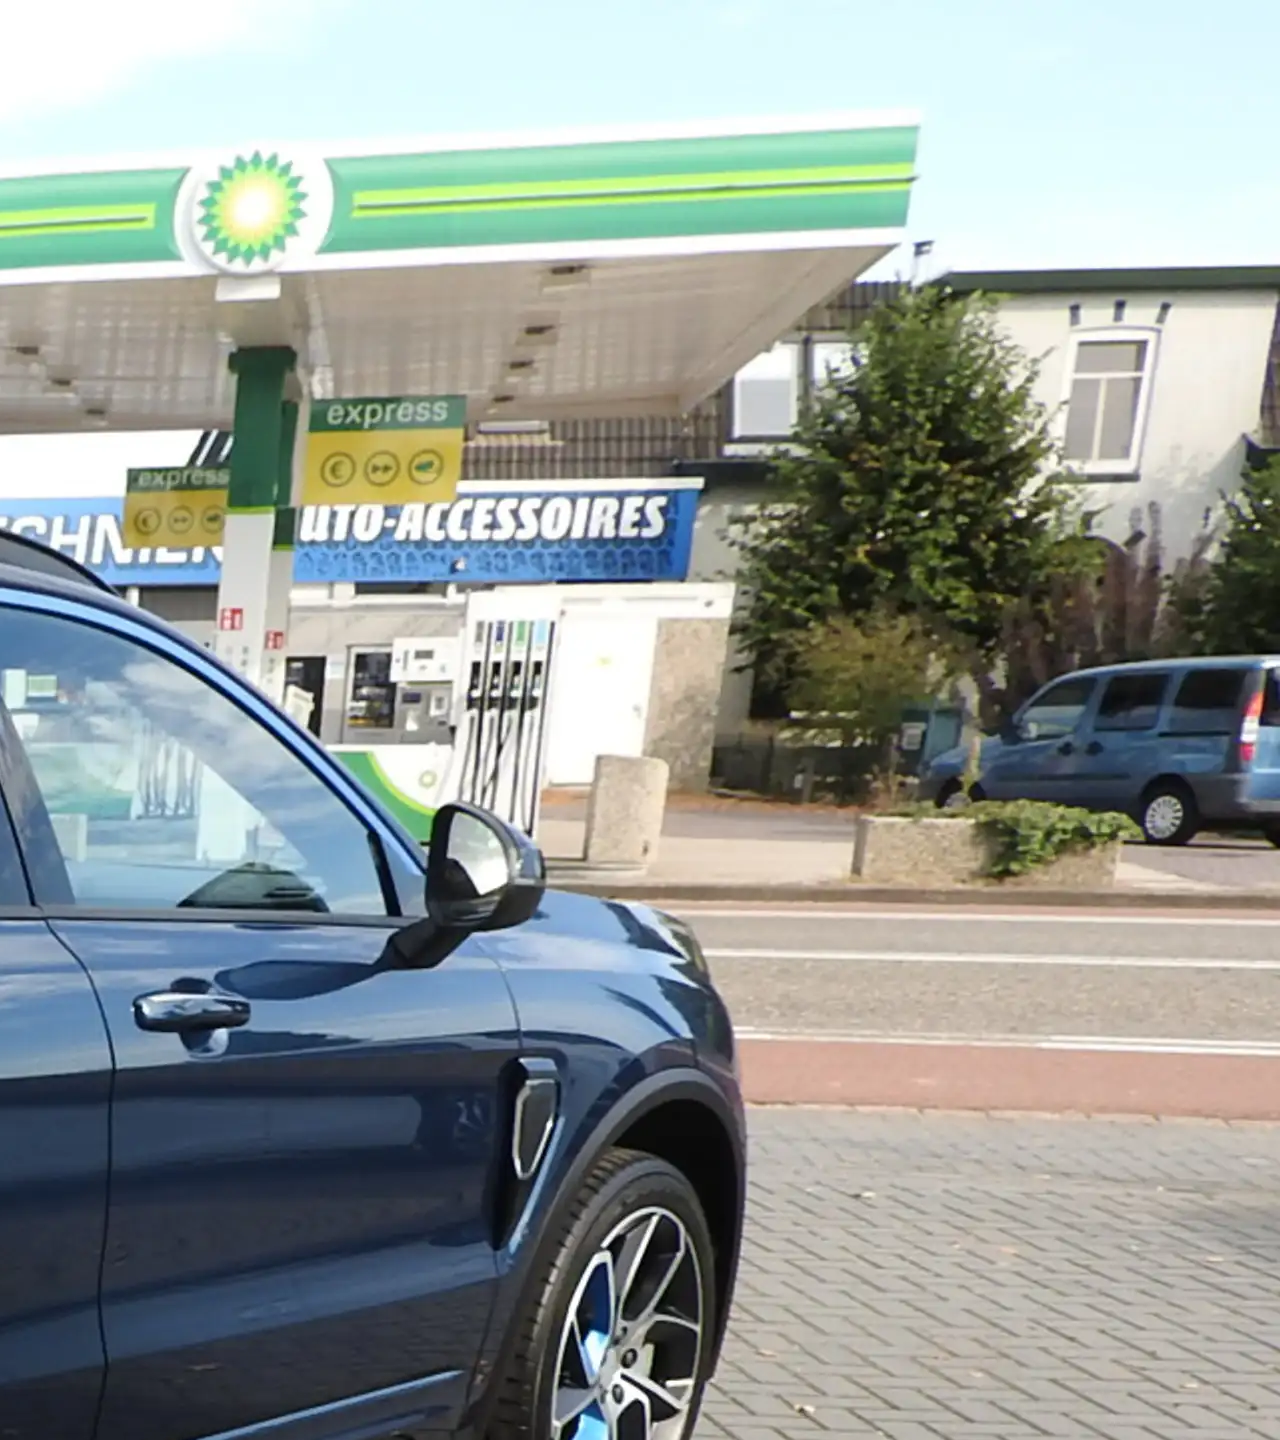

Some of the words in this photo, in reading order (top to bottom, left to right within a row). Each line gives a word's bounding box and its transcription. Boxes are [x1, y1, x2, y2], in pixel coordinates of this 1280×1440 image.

[327, 398, 450, 429] express
[138, 467, 230, 488] express
[300, 496, 668, 542] UTO-ACCESSOIRES
